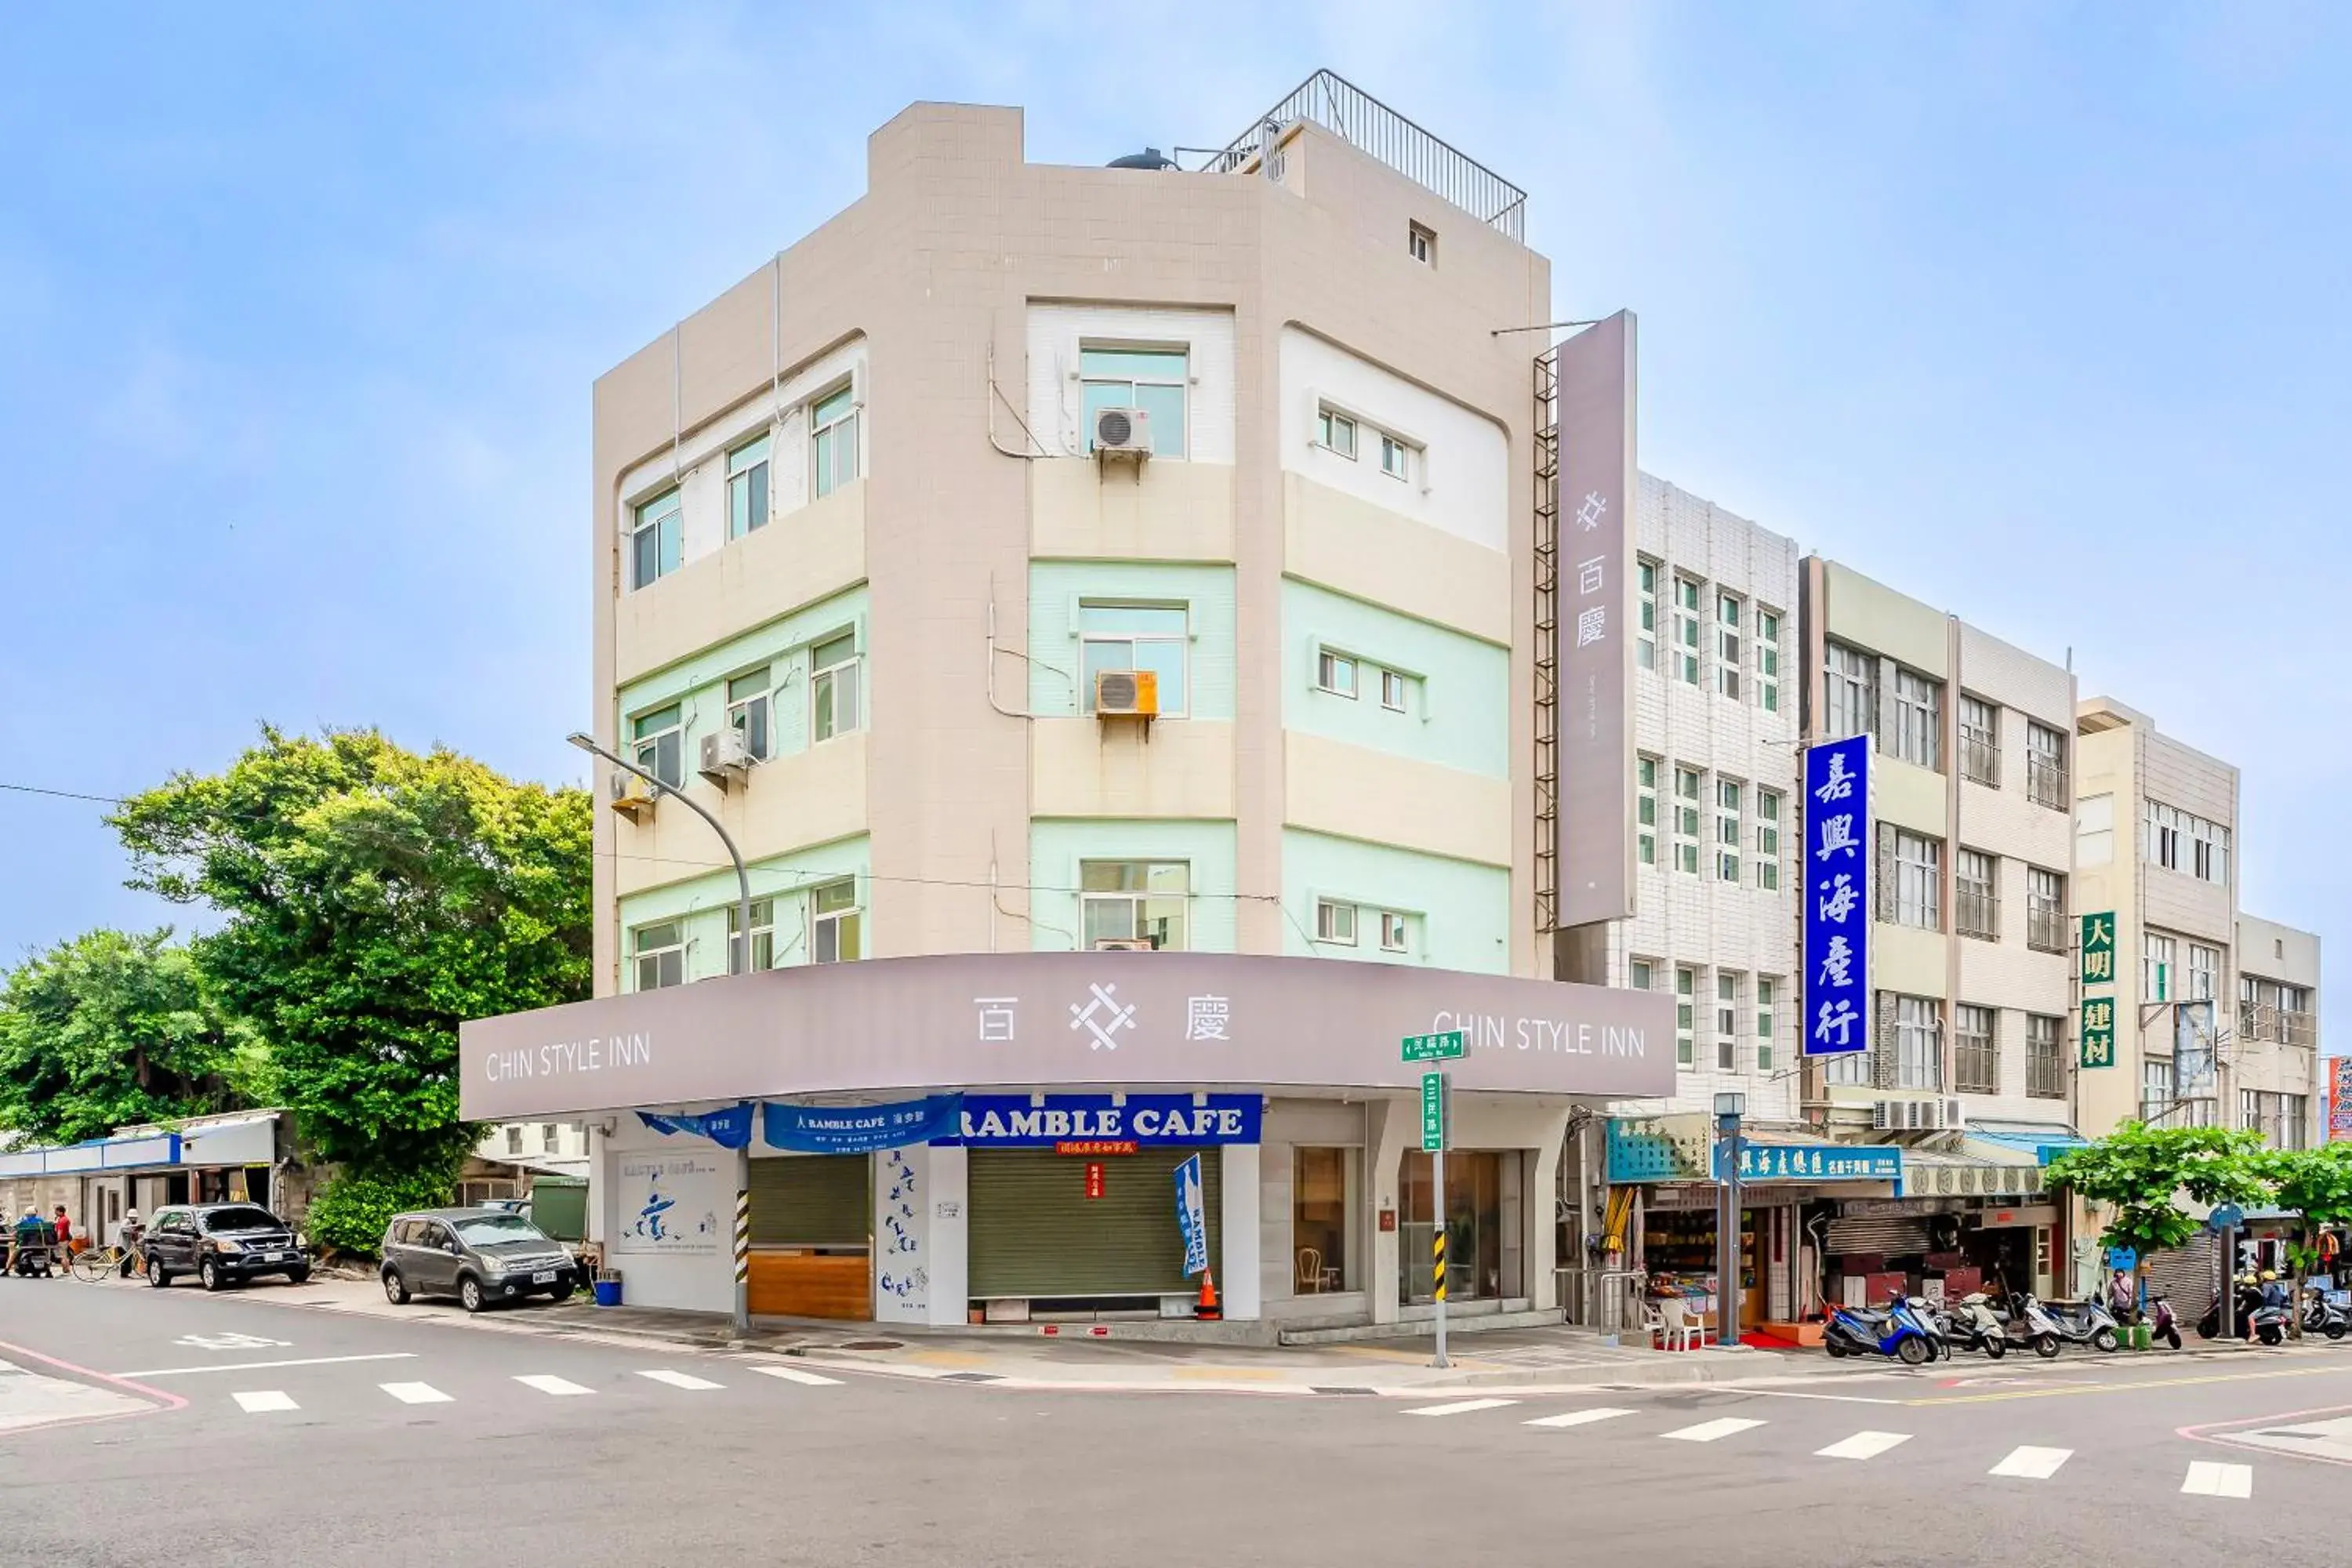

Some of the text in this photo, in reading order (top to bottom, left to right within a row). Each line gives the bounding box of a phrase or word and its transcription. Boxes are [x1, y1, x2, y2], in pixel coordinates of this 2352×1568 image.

[1577, 554, 1606, 648] 百慶
[2085, 918, 2112, 979] 大明
[973, 993, 1230, 1041] 百 慶
[1433, 1011, 1645, 1058] CHIN STYLE INN
[2083, 1003, 2111, 1064] 建材
[485, 1031, 650, 1082] CHIN STYLE INN
[808, 1120, 854, 1130] RAMBLE
[960, 1109, 1243, 1138] RAMBLE CAFE
